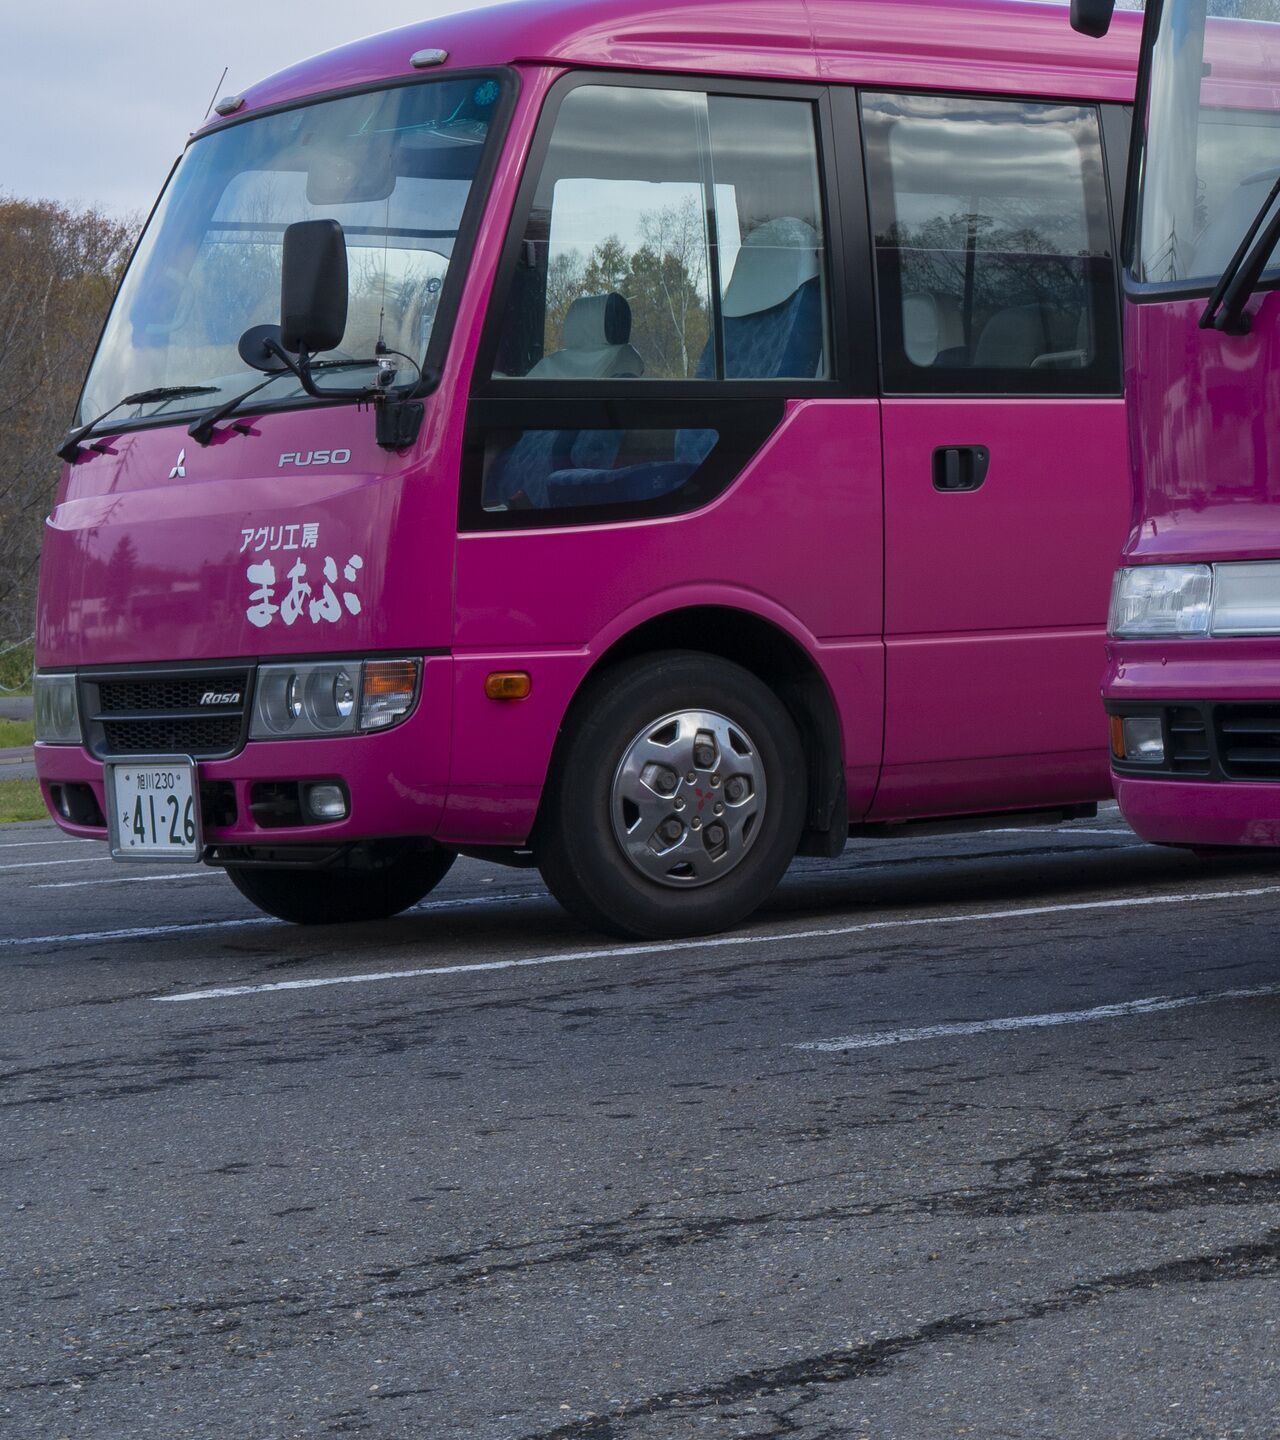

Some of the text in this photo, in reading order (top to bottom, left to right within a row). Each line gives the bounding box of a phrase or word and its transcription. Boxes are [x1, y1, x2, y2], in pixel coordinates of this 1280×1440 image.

[278, 448, 352, 468] FUSO
[239, 522, 320, 553] アグリ工房
[246, 554, 364, 628] まあぶ
